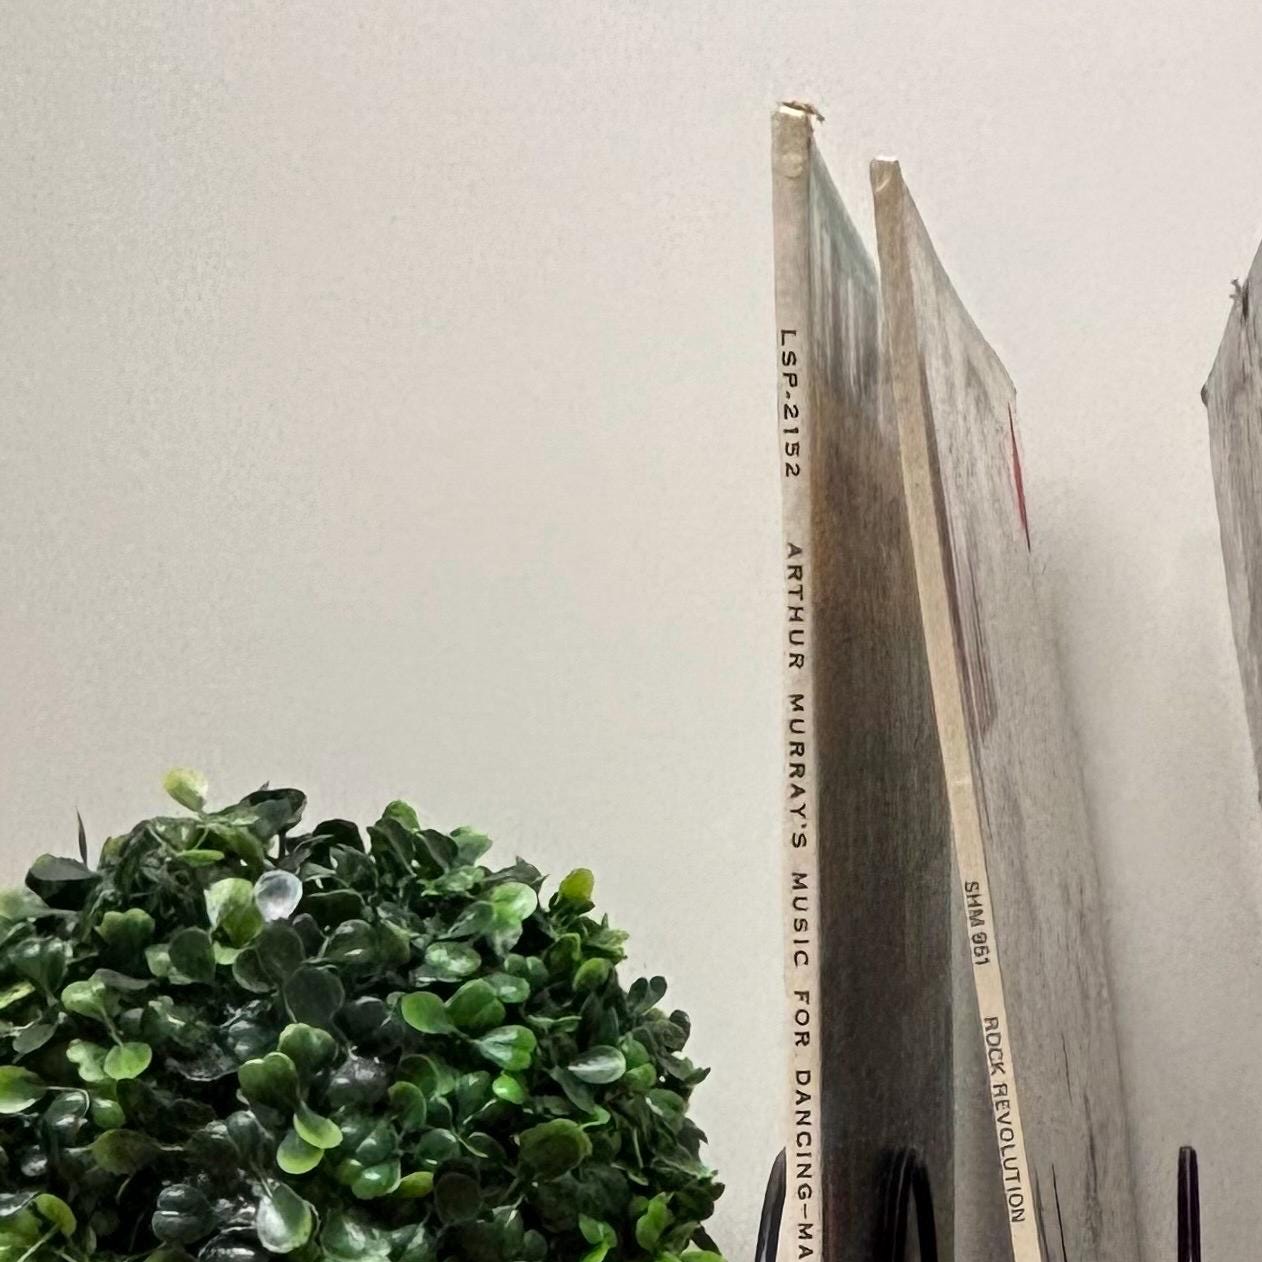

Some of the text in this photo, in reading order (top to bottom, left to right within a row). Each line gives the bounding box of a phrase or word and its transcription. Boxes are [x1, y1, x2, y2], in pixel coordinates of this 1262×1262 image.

[779, 329, 801, 479] LSP-2152
[786, 541, 805, 670] ARTHUR
[788, 693, 808, 850] MURRAY'S
[791, 872, 810, 968] MUSIC
[964, 880, 986, 928] SHM
[794, 989, 811, 1048] FOR
[983, 1015, 1007, 1076] ROCK
[993, 1082, 1027, 1224] REVOLUTION
